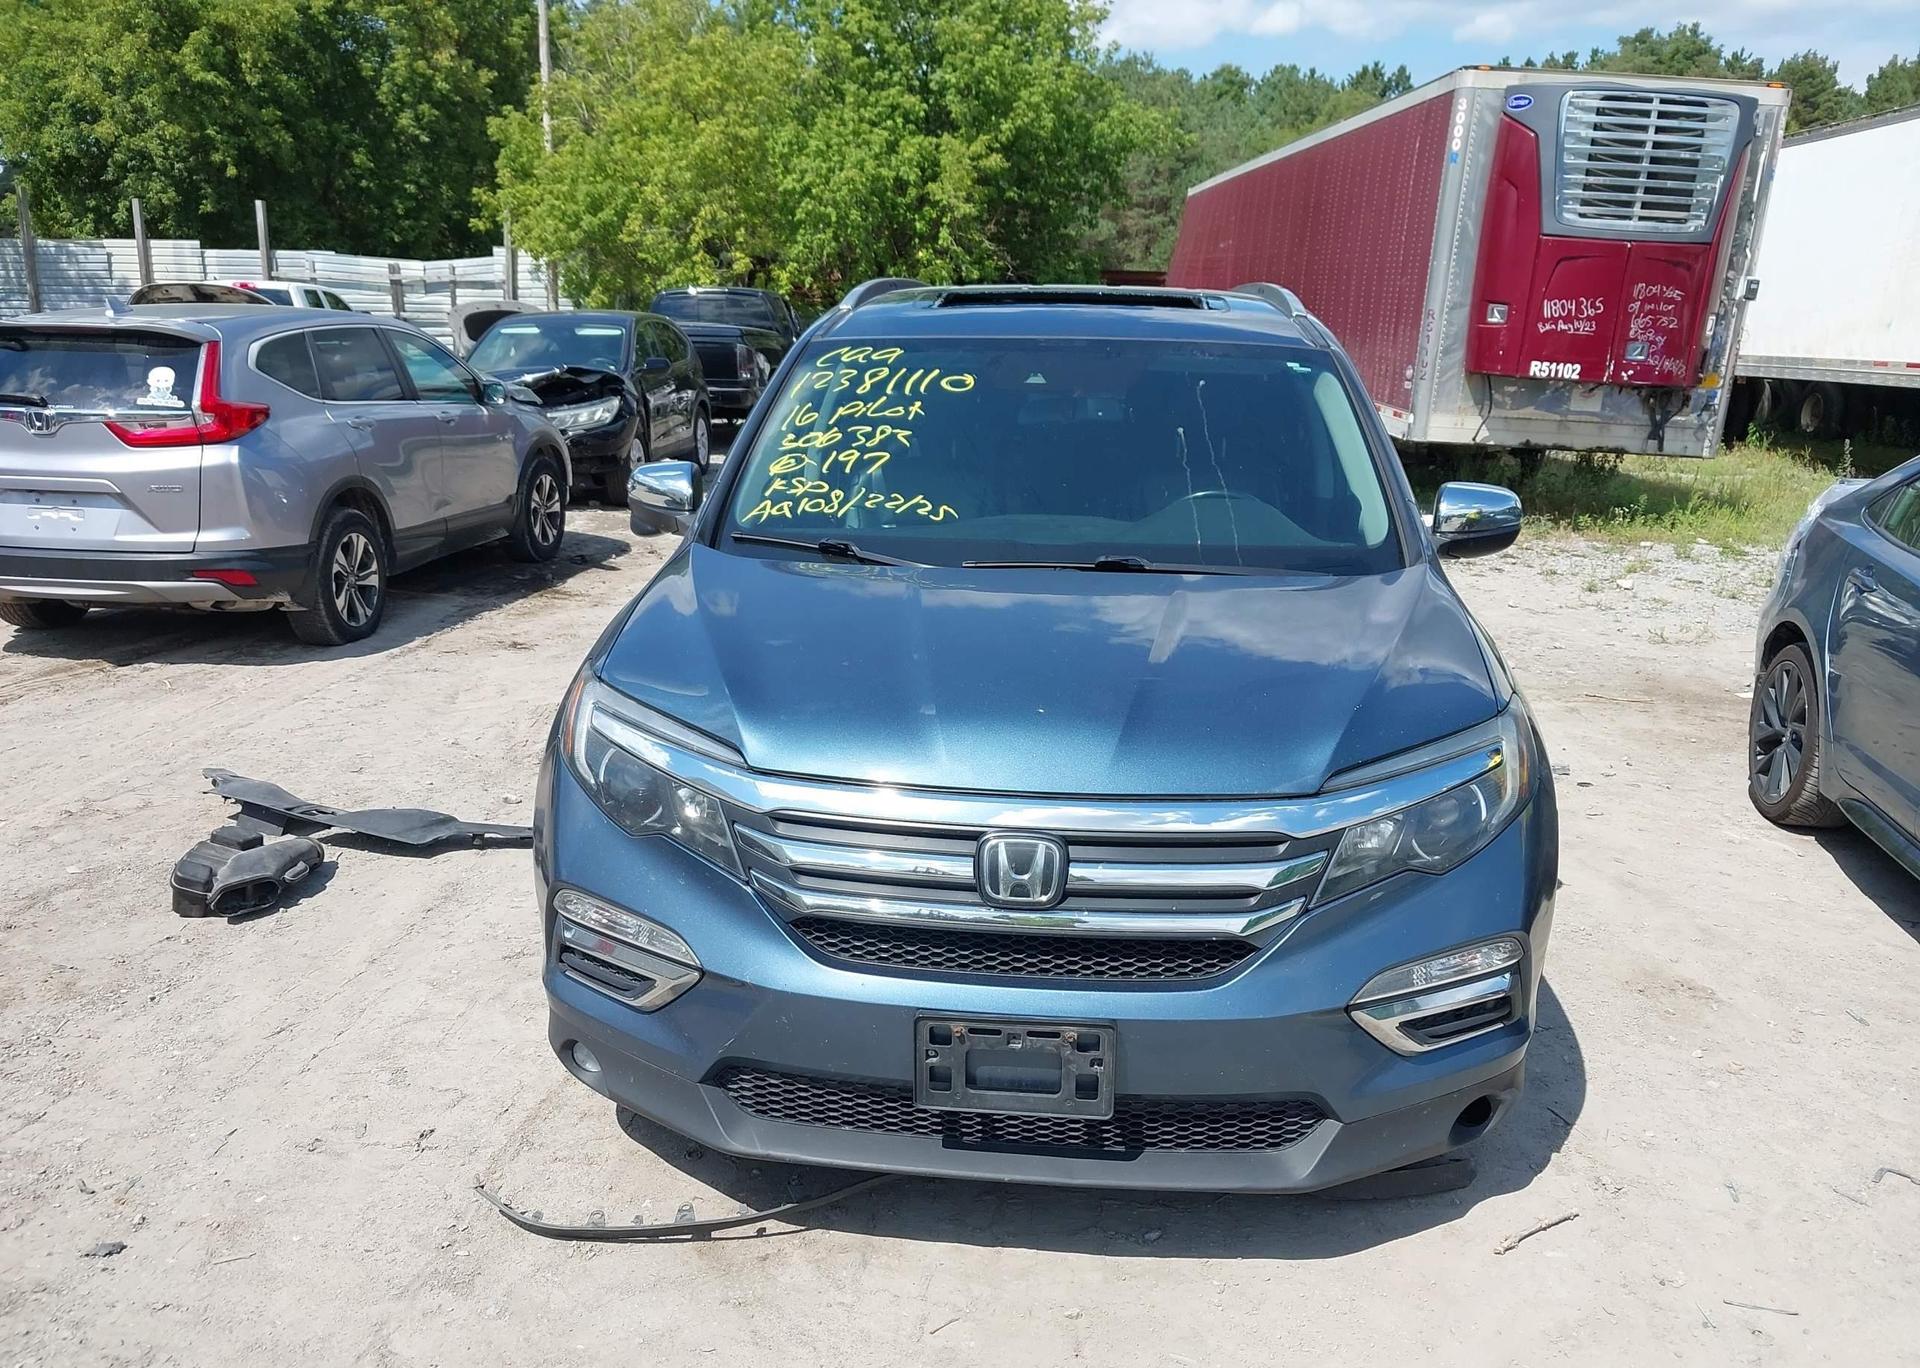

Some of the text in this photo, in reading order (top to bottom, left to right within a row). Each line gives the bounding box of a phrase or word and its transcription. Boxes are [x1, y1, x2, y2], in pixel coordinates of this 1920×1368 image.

[1543, 297, 1604, 319] 11804365
[1529, 360, 1582, 380] R51102
[790, 367, 978, 399] 12381110
[781, 403, 819, 431] 16
